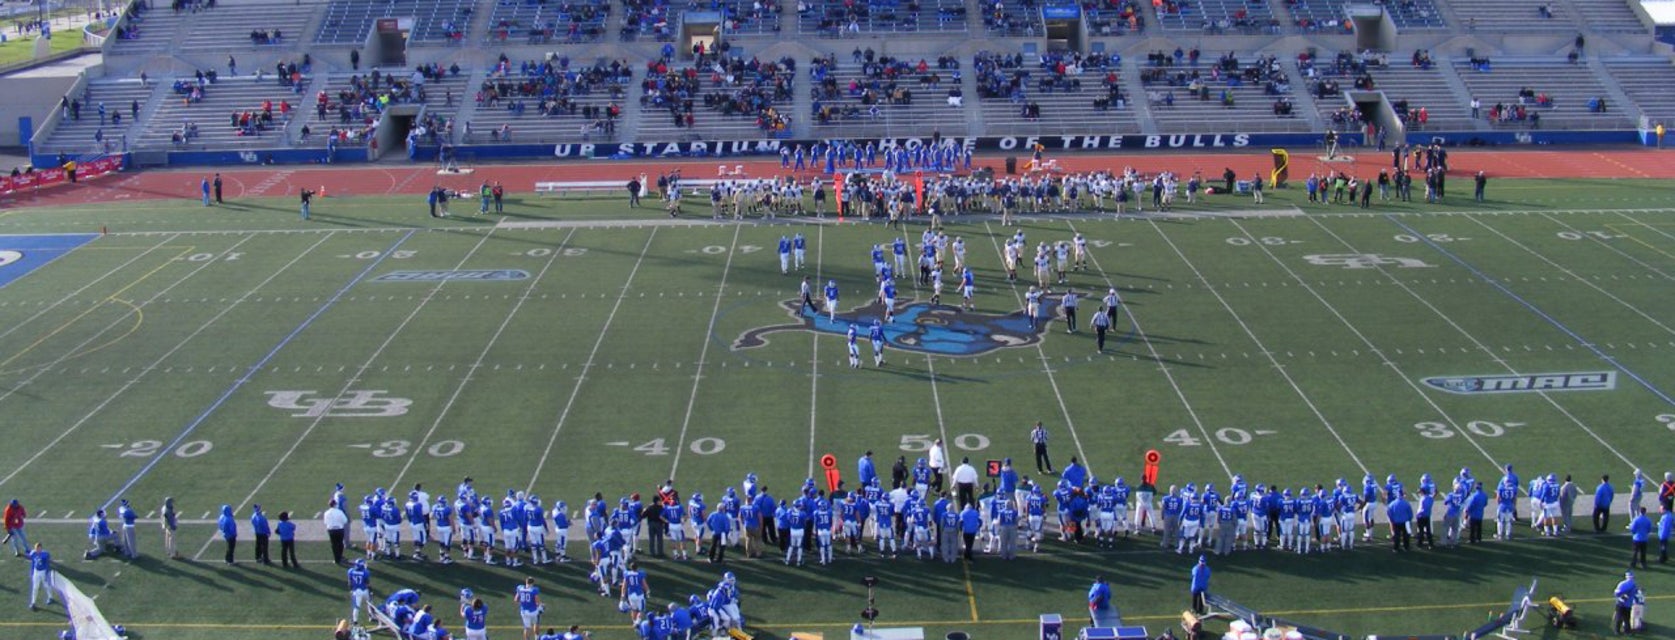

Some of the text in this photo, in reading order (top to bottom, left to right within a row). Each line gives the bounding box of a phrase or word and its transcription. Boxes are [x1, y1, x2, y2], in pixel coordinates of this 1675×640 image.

[1000, 136, 1039, 149] OF
[1061, 135, 1123, 149] THE
[1144, 134, 1250, 148] BULLS
[1481, 373, 1608, 391] MAC
[264, 390, 413, 417] UB
[1162, 428, 1252, 446] 40
[1414, 421, 1504, 438] 30
[120, 440, 213, 457] 20
[373, 440, 465, 457] 30
[633, 437, 726, 455] 40
[899, 433, 991, 451] 50
[988, 462, 999, 475] 3
[1030, 500, 1042, 509] 44
[520, 593, 531, 603] 80
[660, 619, 672, 630] 21
